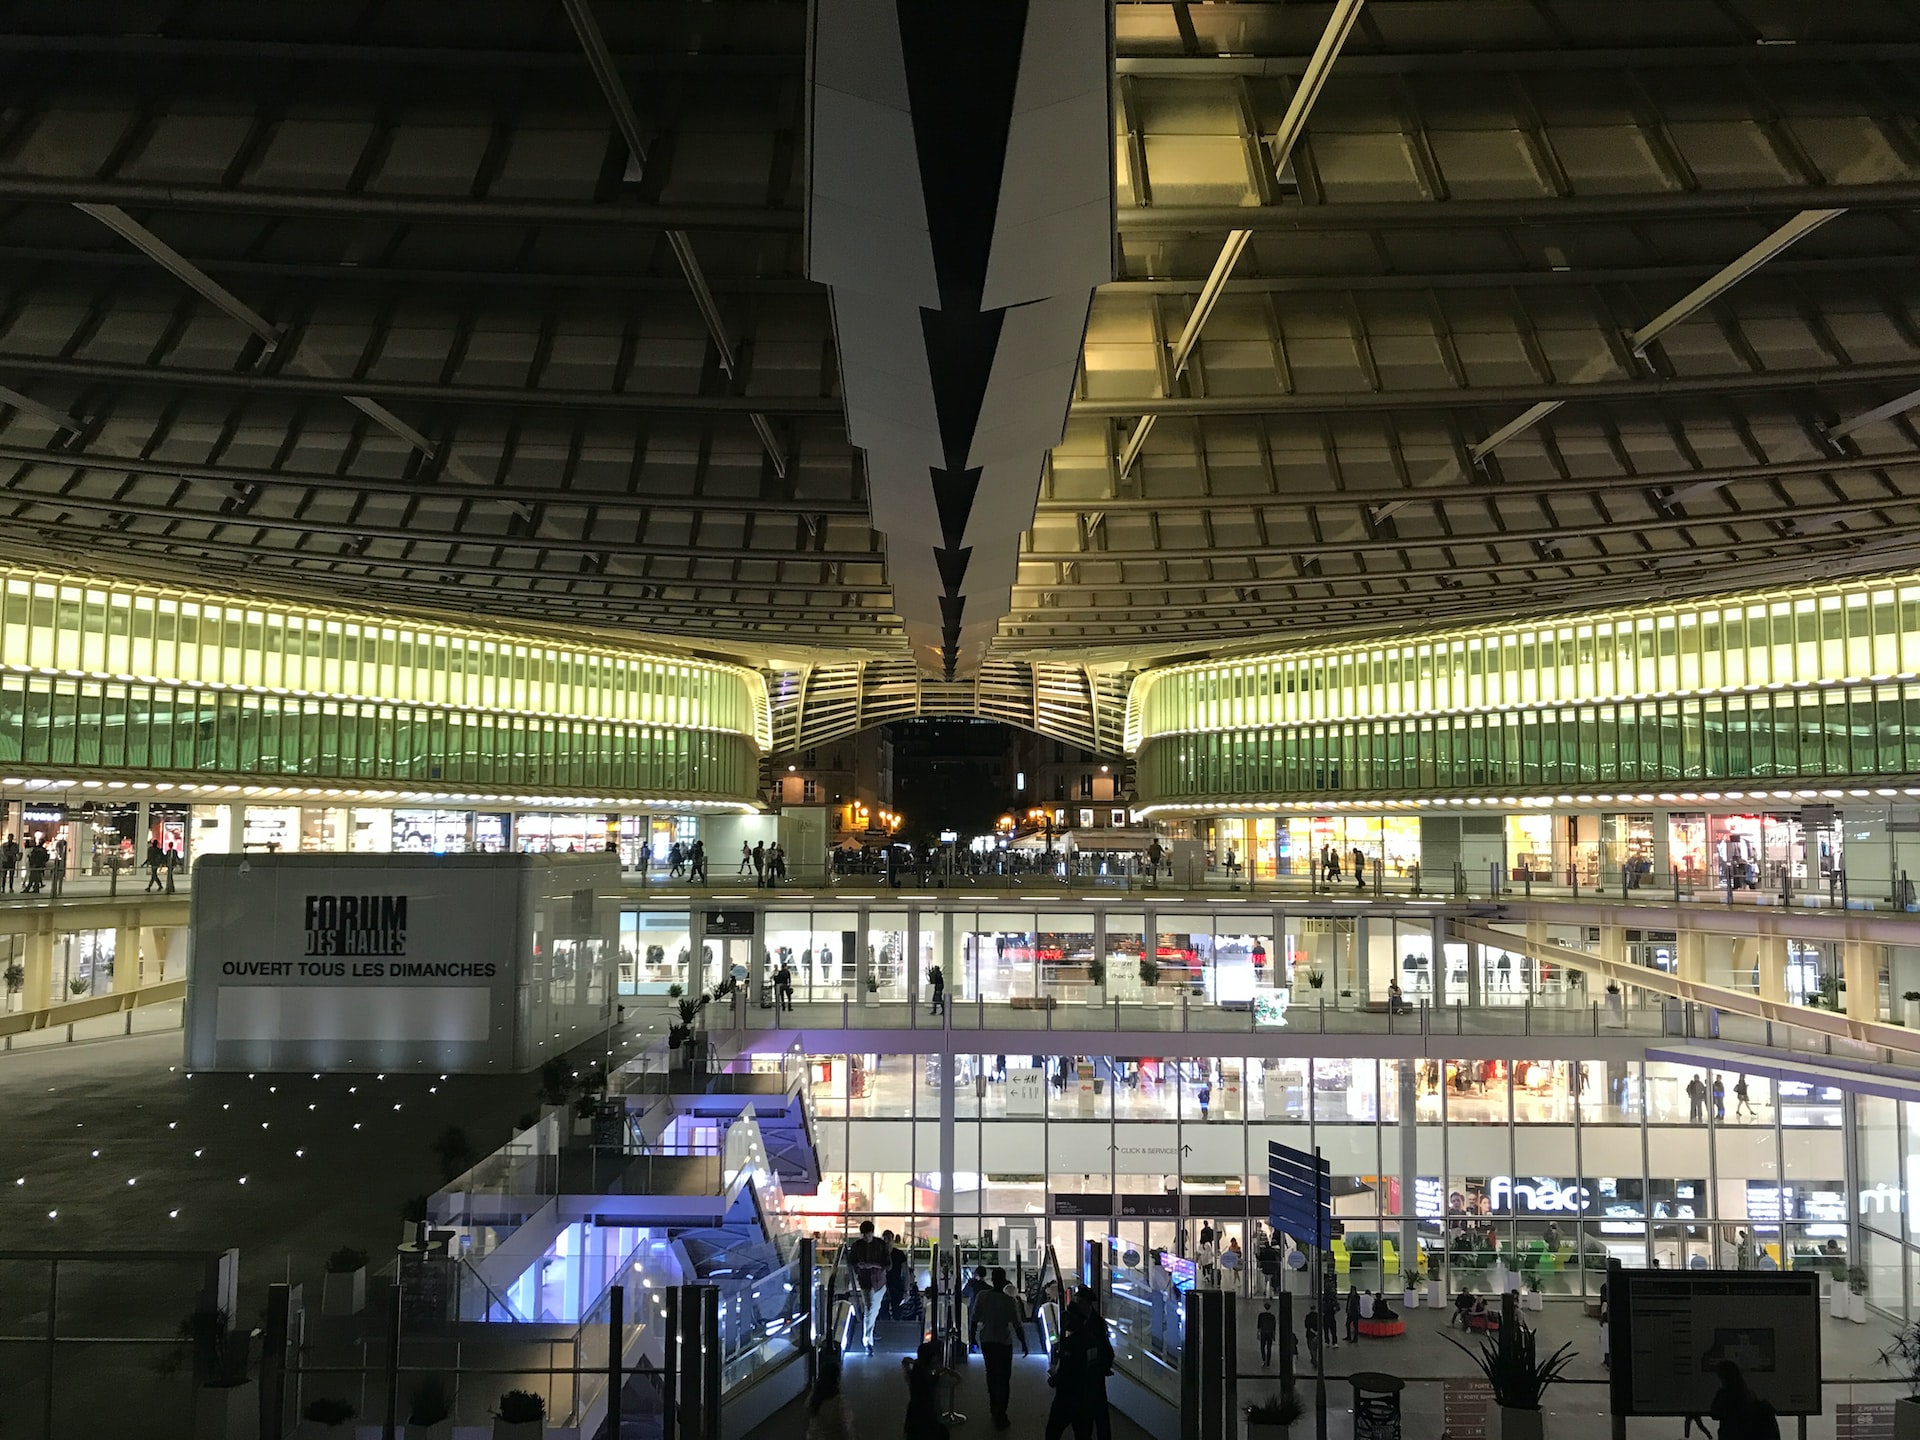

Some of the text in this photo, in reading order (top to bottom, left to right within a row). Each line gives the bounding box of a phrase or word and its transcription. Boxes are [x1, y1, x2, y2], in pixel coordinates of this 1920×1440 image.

[305, 896, 407, 930] FORUM
[306, 930, 406, 954] DES HALLES
[222, 961, 496, 977] OUVERT TOUS LES DIMANCHES
[1489, 1175, 1591, 1212] fnac
